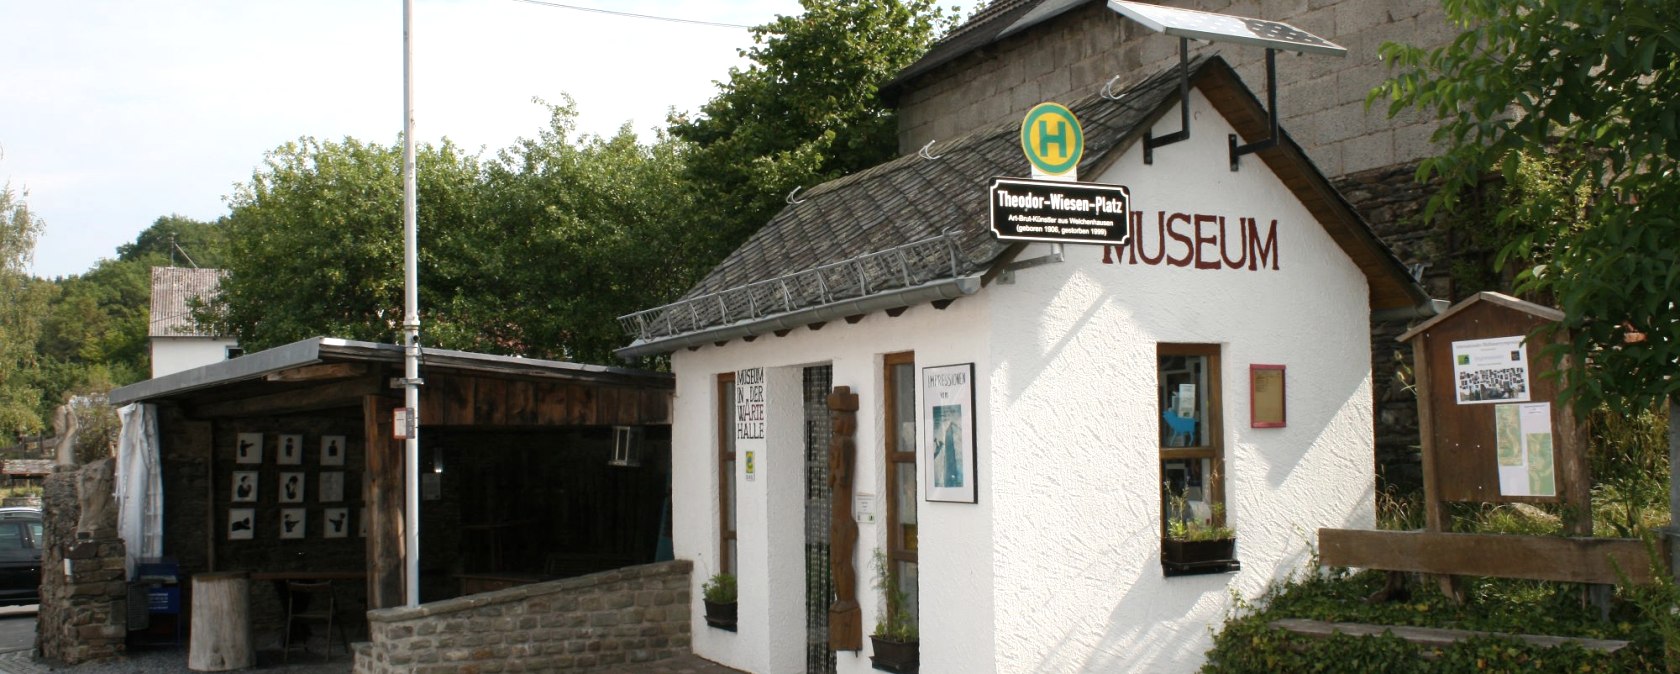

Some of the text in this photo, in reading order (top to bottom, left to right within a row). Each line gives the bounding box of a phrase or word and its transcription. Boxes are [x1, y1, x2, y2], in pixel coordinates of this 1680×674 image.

[1038, 119, 1068, 158] H
[998, 190, 1122, 214] Theodor-Wiesen-Platz
[1008, 214, 1057, 224] Art-Brut-Künstler
[1016, 224, 1043, 233] (geboren
[1061, 226, 1090, 235] gestorben
[737, 367, 764, 385] MUSEUM
[737, 386, 764, 404] IN DER
[737, 422, 764, 440] HALLE
